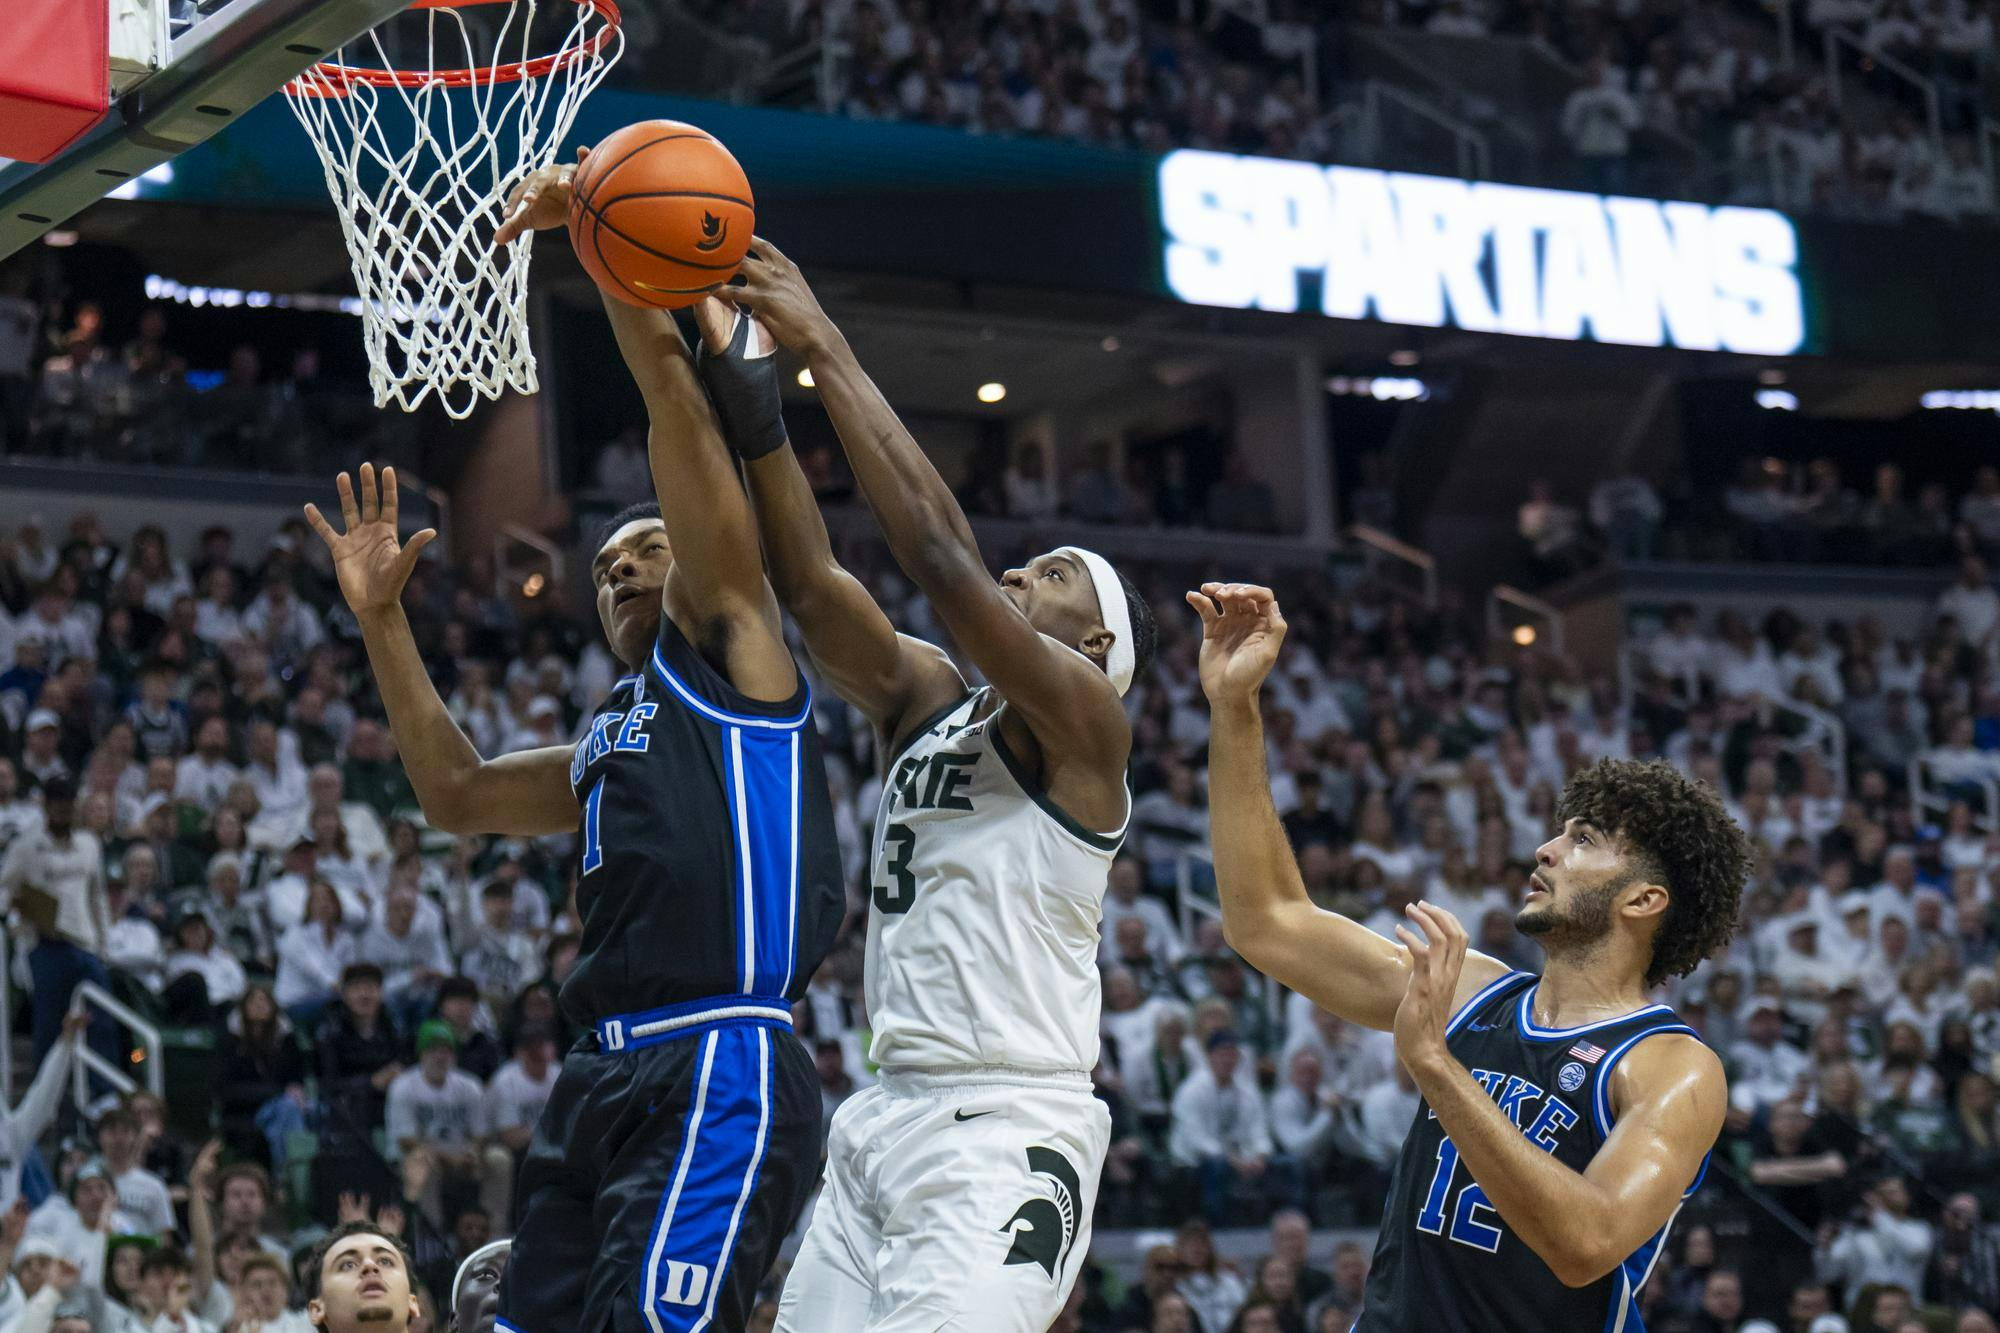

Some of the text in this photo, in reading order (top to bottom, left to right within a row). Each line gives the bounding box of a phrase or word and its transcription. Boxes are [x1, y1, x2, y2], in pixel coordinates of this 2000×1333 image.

[1159, 149, 1805, 355] SPARTANS
[571, 703, 659, 786] UKE
[583, 773, 605, 876] 1
[873, 824, 916, 914] 3
[1428, 1068, 1580, 1154] KE
[1416, 1135, 1502, 1254] 12
[659, 1259, 709, 1306] D
